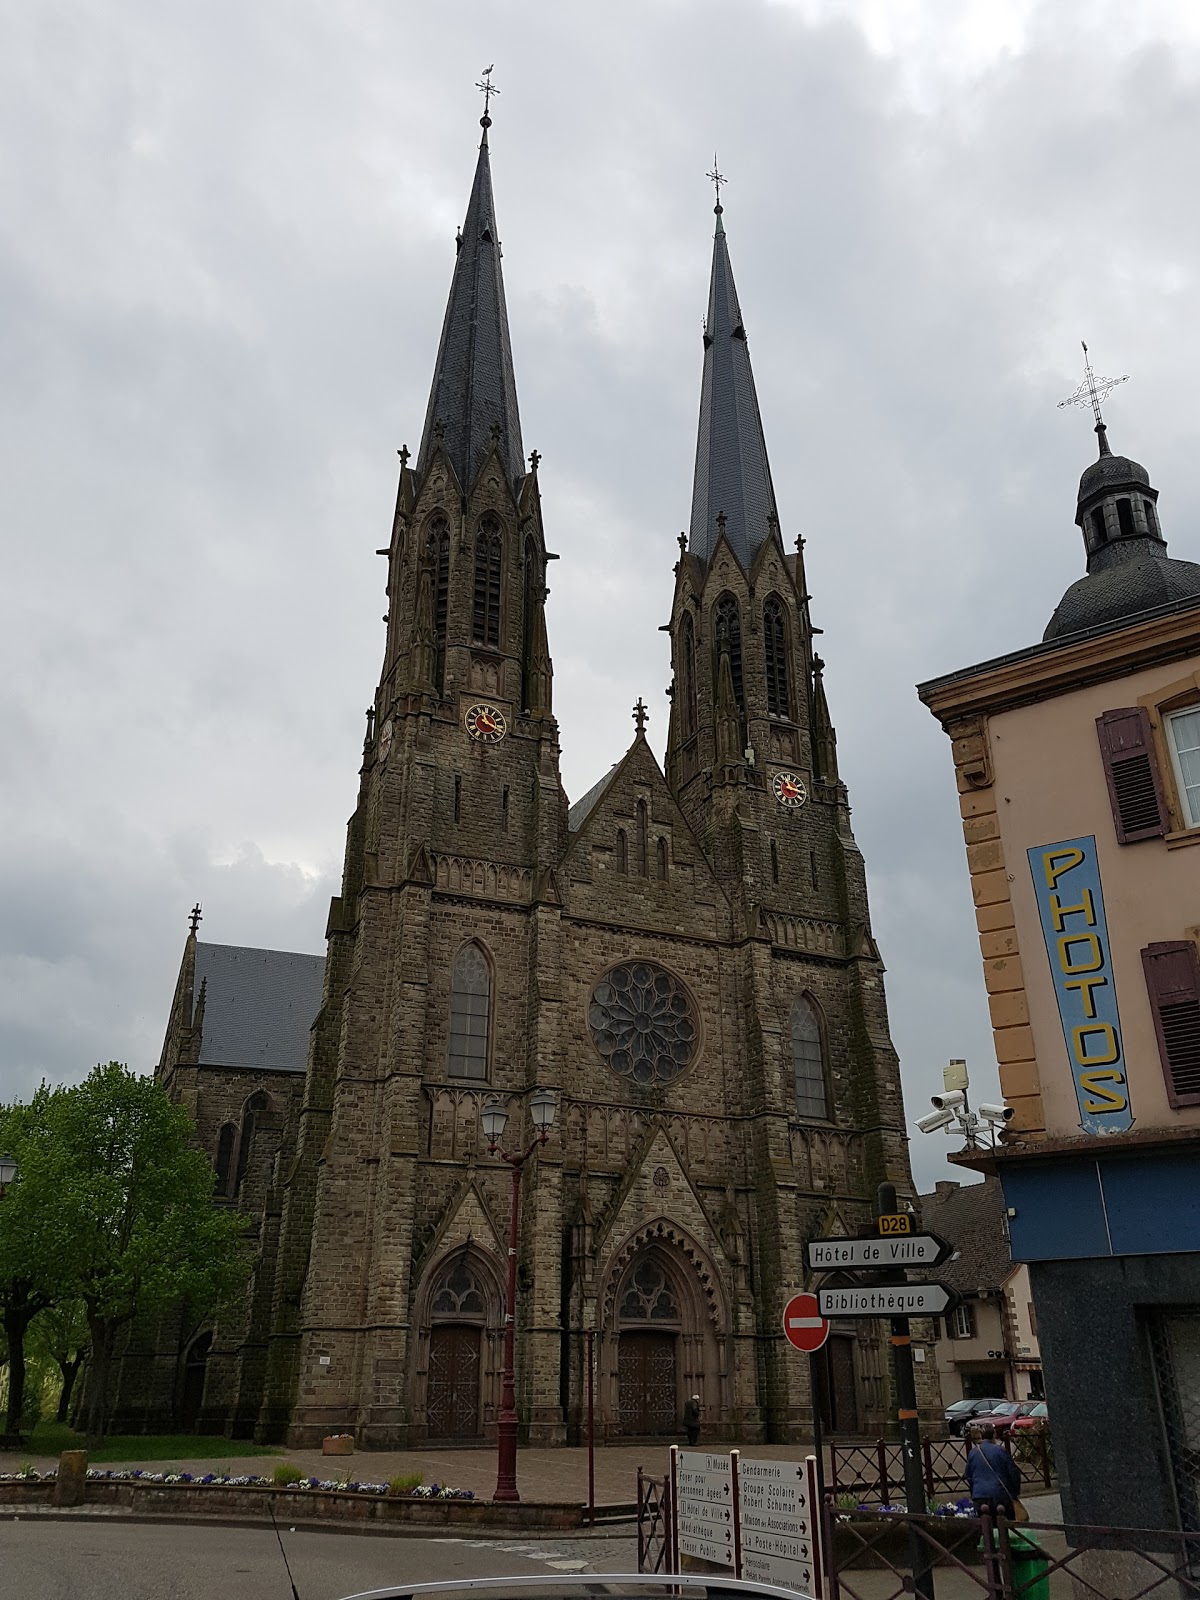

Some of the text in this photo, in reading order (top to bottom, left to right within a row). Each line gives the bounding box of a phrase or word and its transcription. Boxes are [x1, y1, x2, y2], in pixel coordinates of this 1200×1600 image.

[1042, 847, 1126, 1115] PHOTOS
[881, 1217, 907, 1232] D28
[815, 1243, 925, 1262] Hôtel de Ville
[826, 1293, 925, 1312] Bibliothèque
[713, 1458, 729, 1471] Musée
[742, 1463, 781, 1478] Gendarmerie
[680, 1470, 706, 1485] Foyer pour
[680, 1485, 704, 1497] personnes
[743, 1481, 795, 1499] Groupe Scolaire
[702, 1505, 708, 1517] de
[743, 1494, 796, 1513] Robert Schuman
[744, 1513, 760, 1527] Maison
[767, 1516, 799, 1533] Associations
[745, 1534, 752, 1546] La
[699, 1543, 716, 1558] Public
